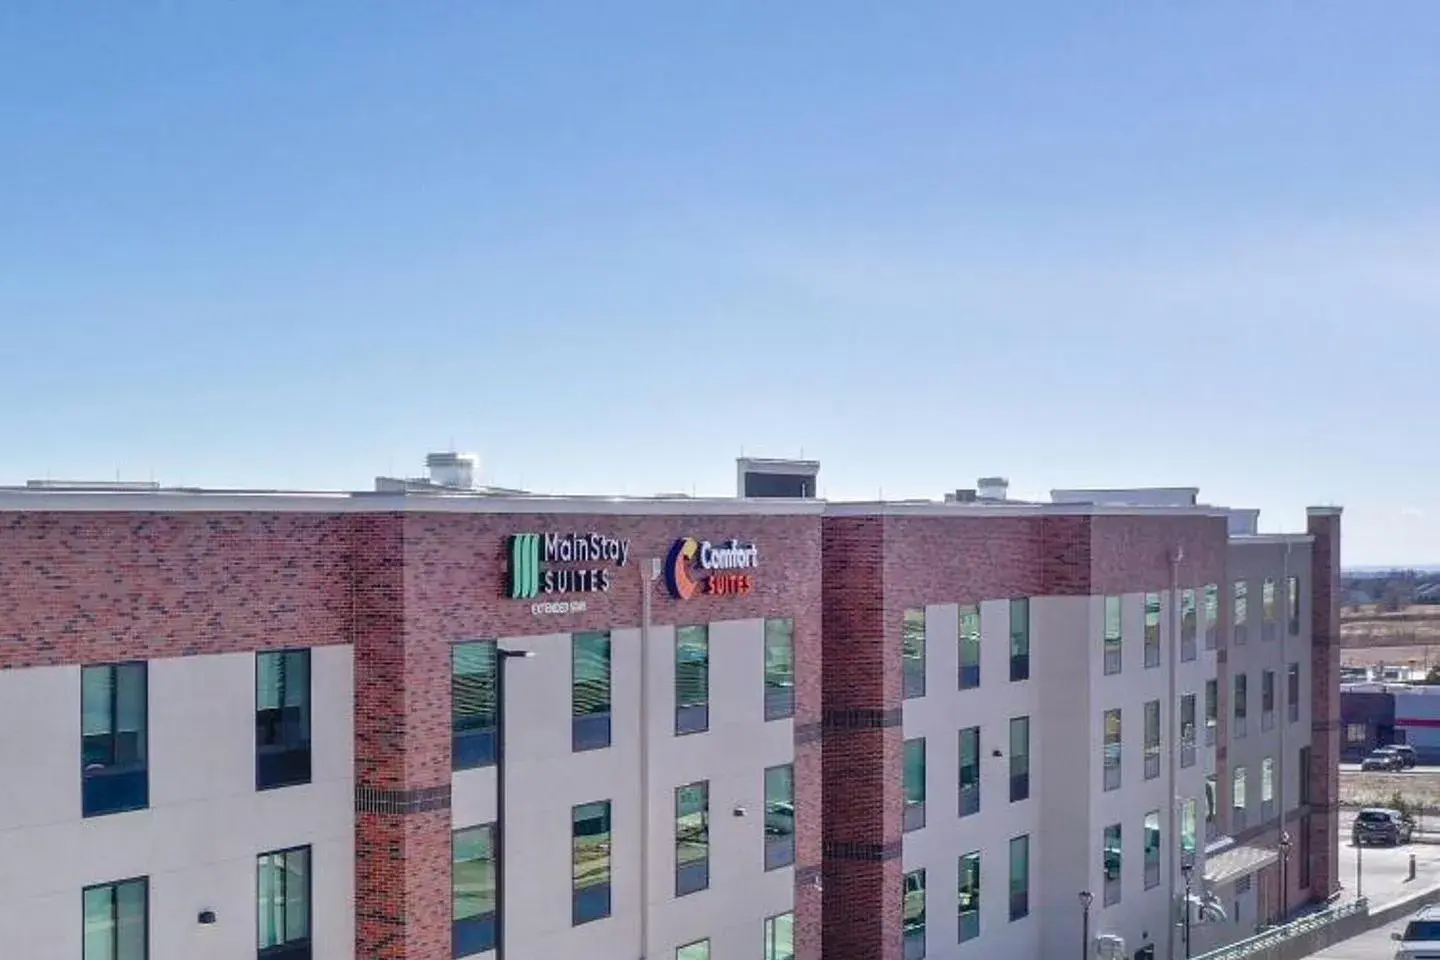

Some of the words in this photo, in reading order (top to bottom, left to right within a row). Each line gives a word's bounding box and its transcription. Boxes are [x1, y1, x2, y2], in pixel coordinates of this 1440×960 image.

[545, 532, 630, 567] MainStay
[701, 540, 759, 569] Comfort
[545, 569, 611, 595] SUITES
[709, 573, 752, 596] SUITES
